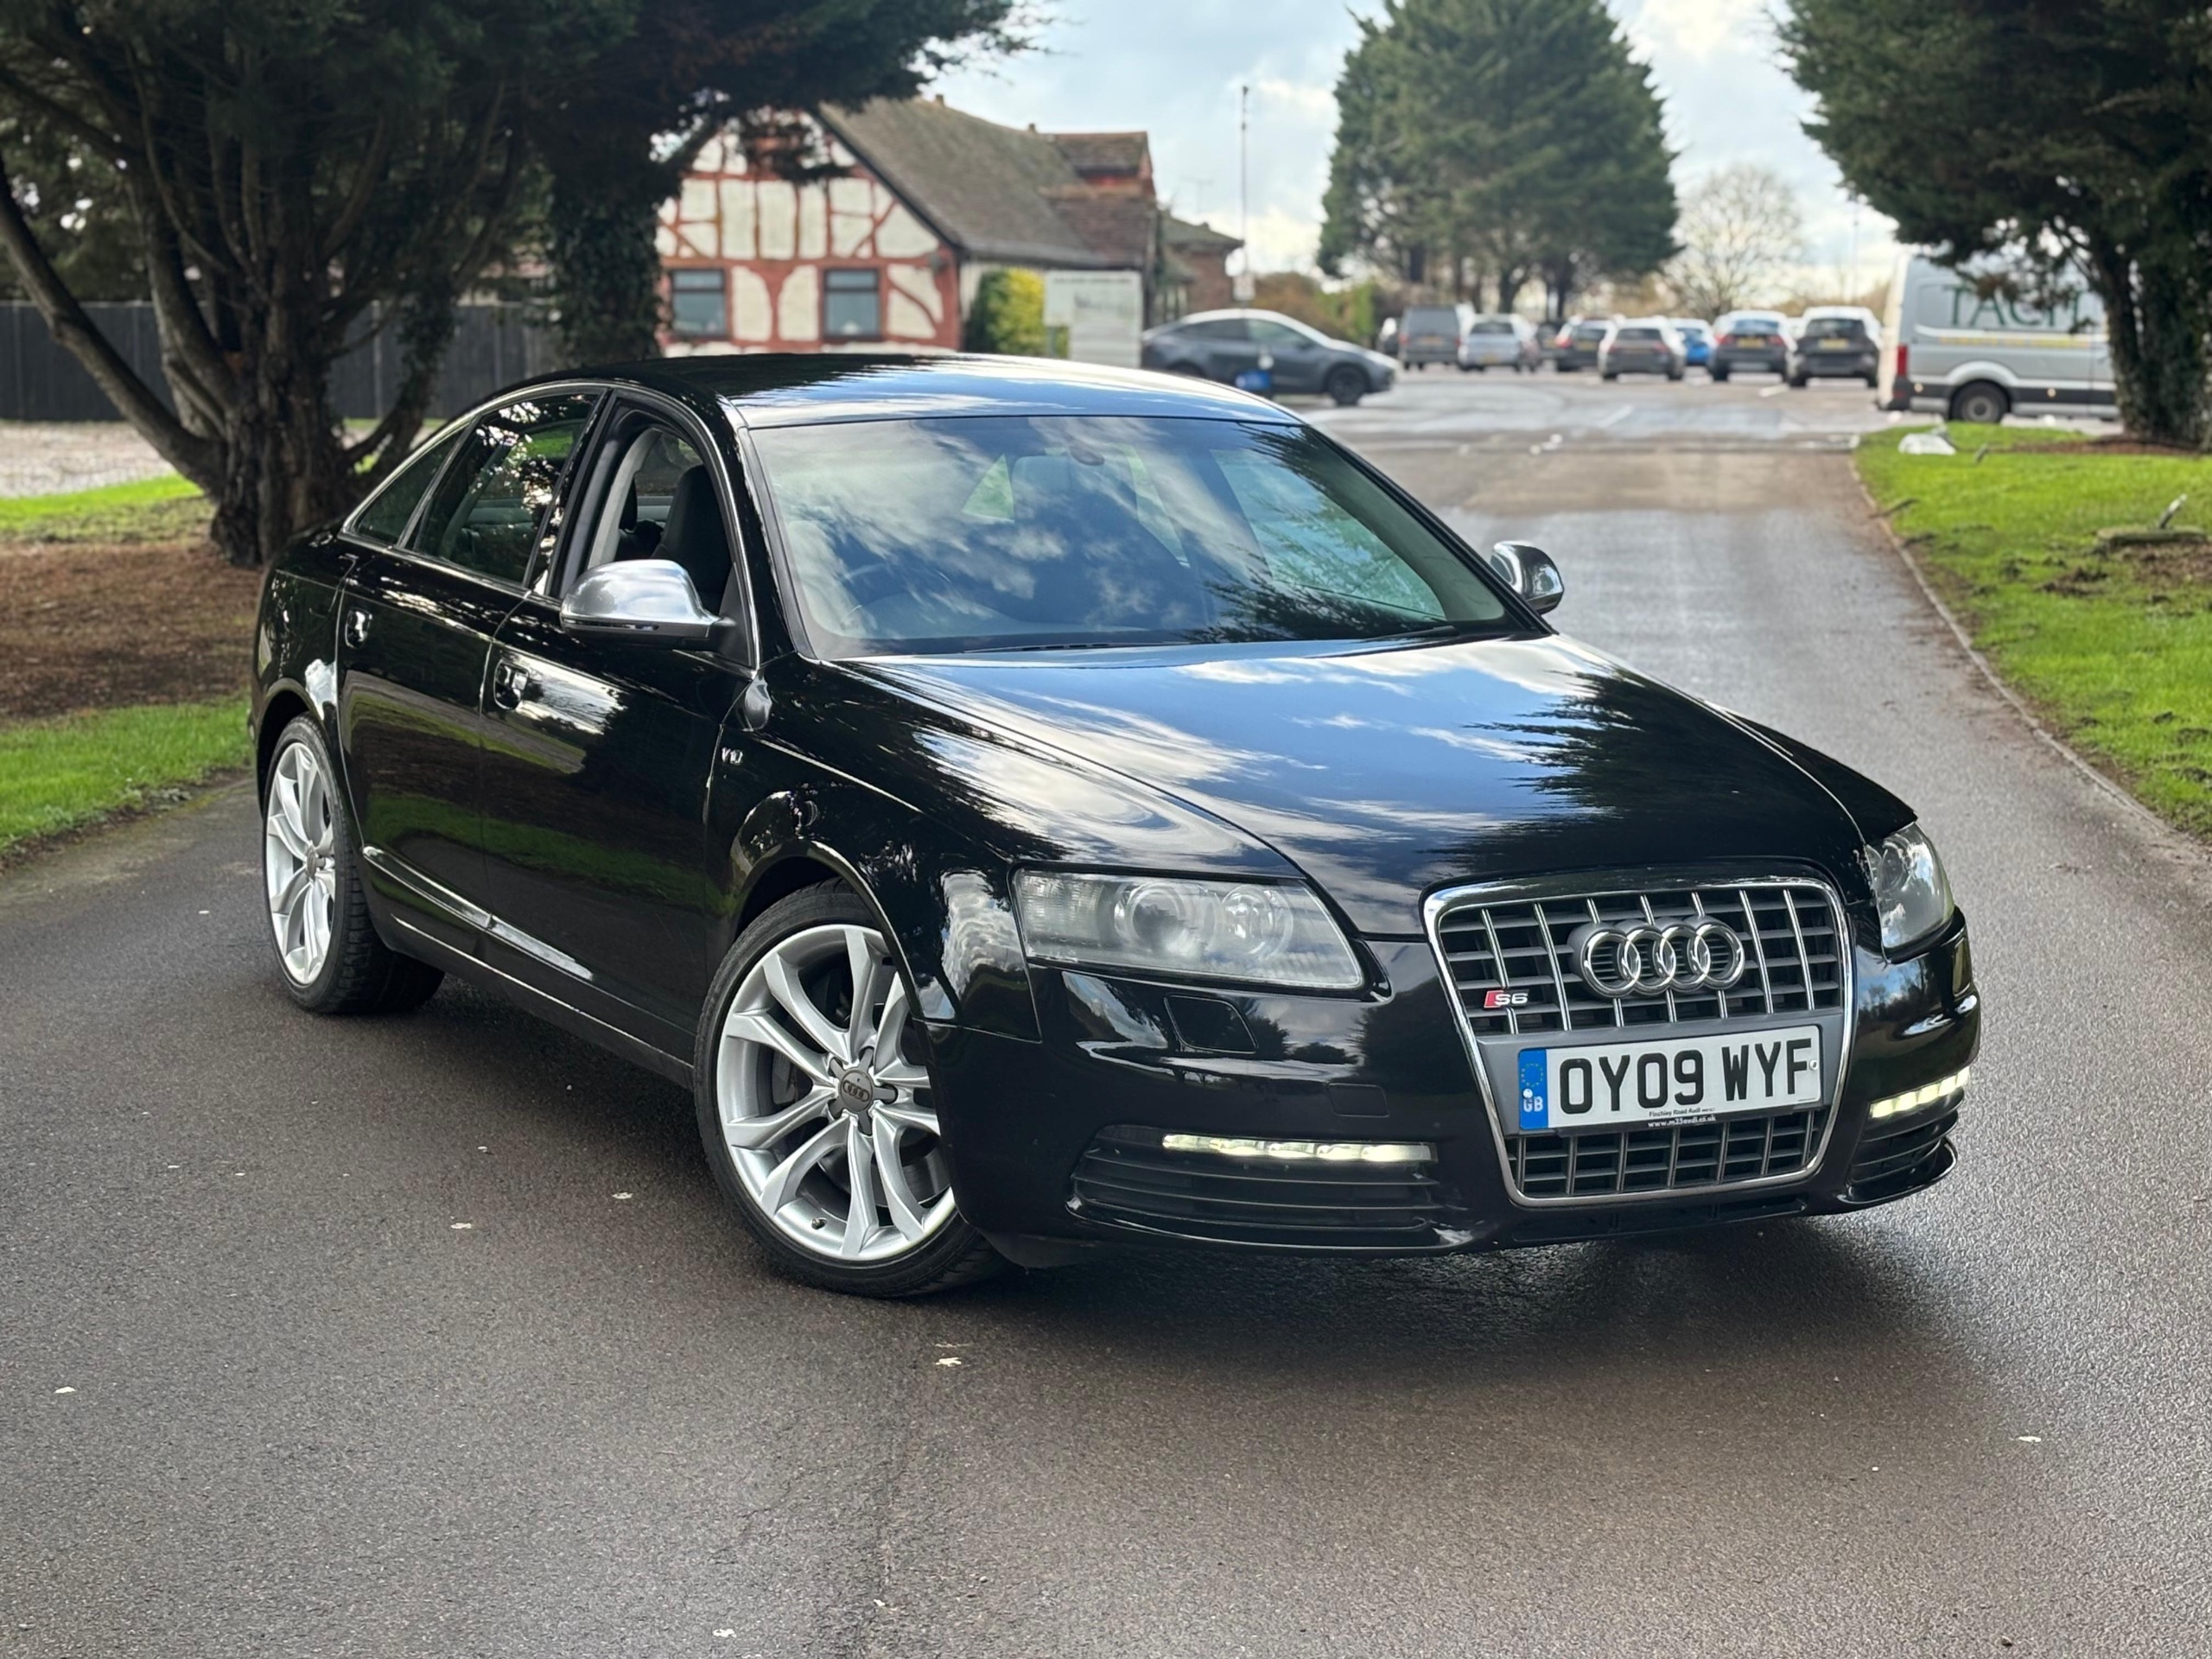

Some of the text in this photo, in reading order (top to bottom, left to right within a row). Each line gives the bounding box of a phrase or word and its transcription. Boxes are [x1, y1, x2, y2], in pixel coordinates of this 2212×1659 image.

[1495, 993, 1529, 1006] S6
[1560, 1038, 1812, 1115] OY09 WYF
[1522, 1096, 1543, 1112] GB
